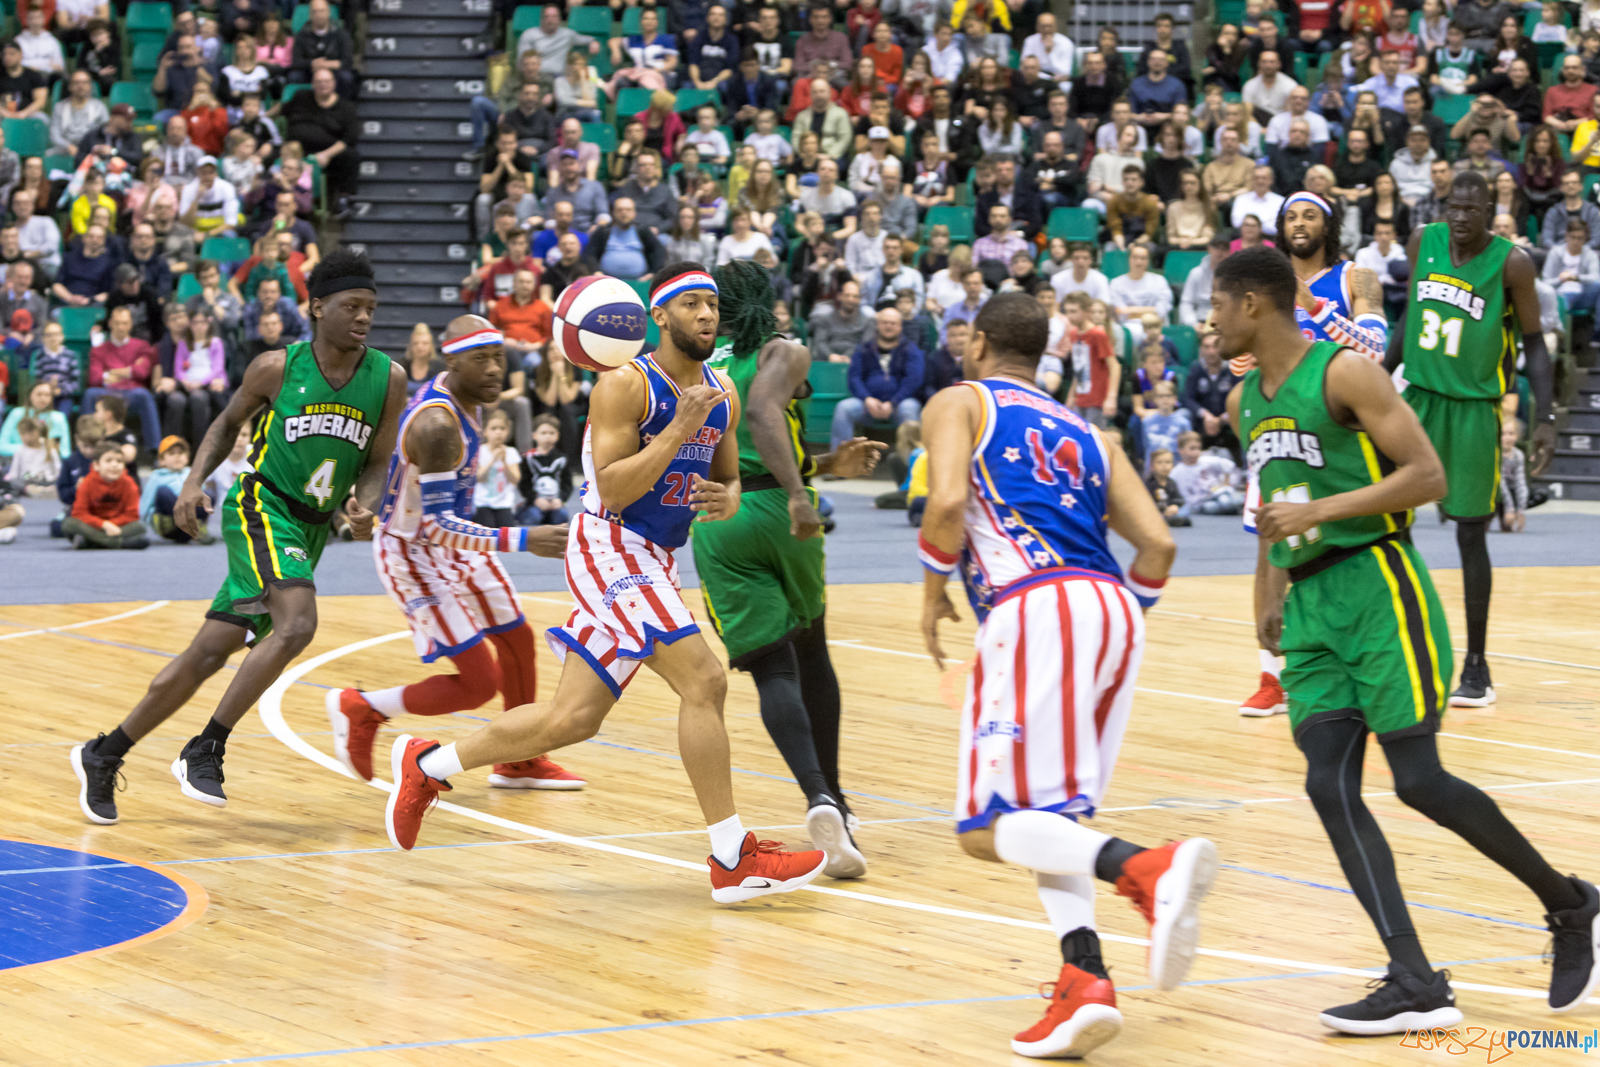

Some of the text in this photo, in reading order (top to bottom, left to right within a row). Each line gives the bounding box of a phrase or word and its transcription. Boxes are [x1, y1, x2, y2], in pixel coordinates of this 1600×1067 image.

[372, 38, 397, 50] 11
[363, 79, 392, 93] 10
[455, 80, 484, 93] 10
[363, 121, 382, 134] 9
[354, 203, 372, 216] 7
[451, 204, 468, 217] 7
[1418, 309, 1464, 357] 31
[305, 403, 363, 420] WASHINGTON
[284, 413, 372, 450] GENERALS
[1025, 427, 1086, 490] 14
[304, 458, 337, 507] 4
[661, 471, 695, 506] 21
[1548, 482, 1563, 498] 1
